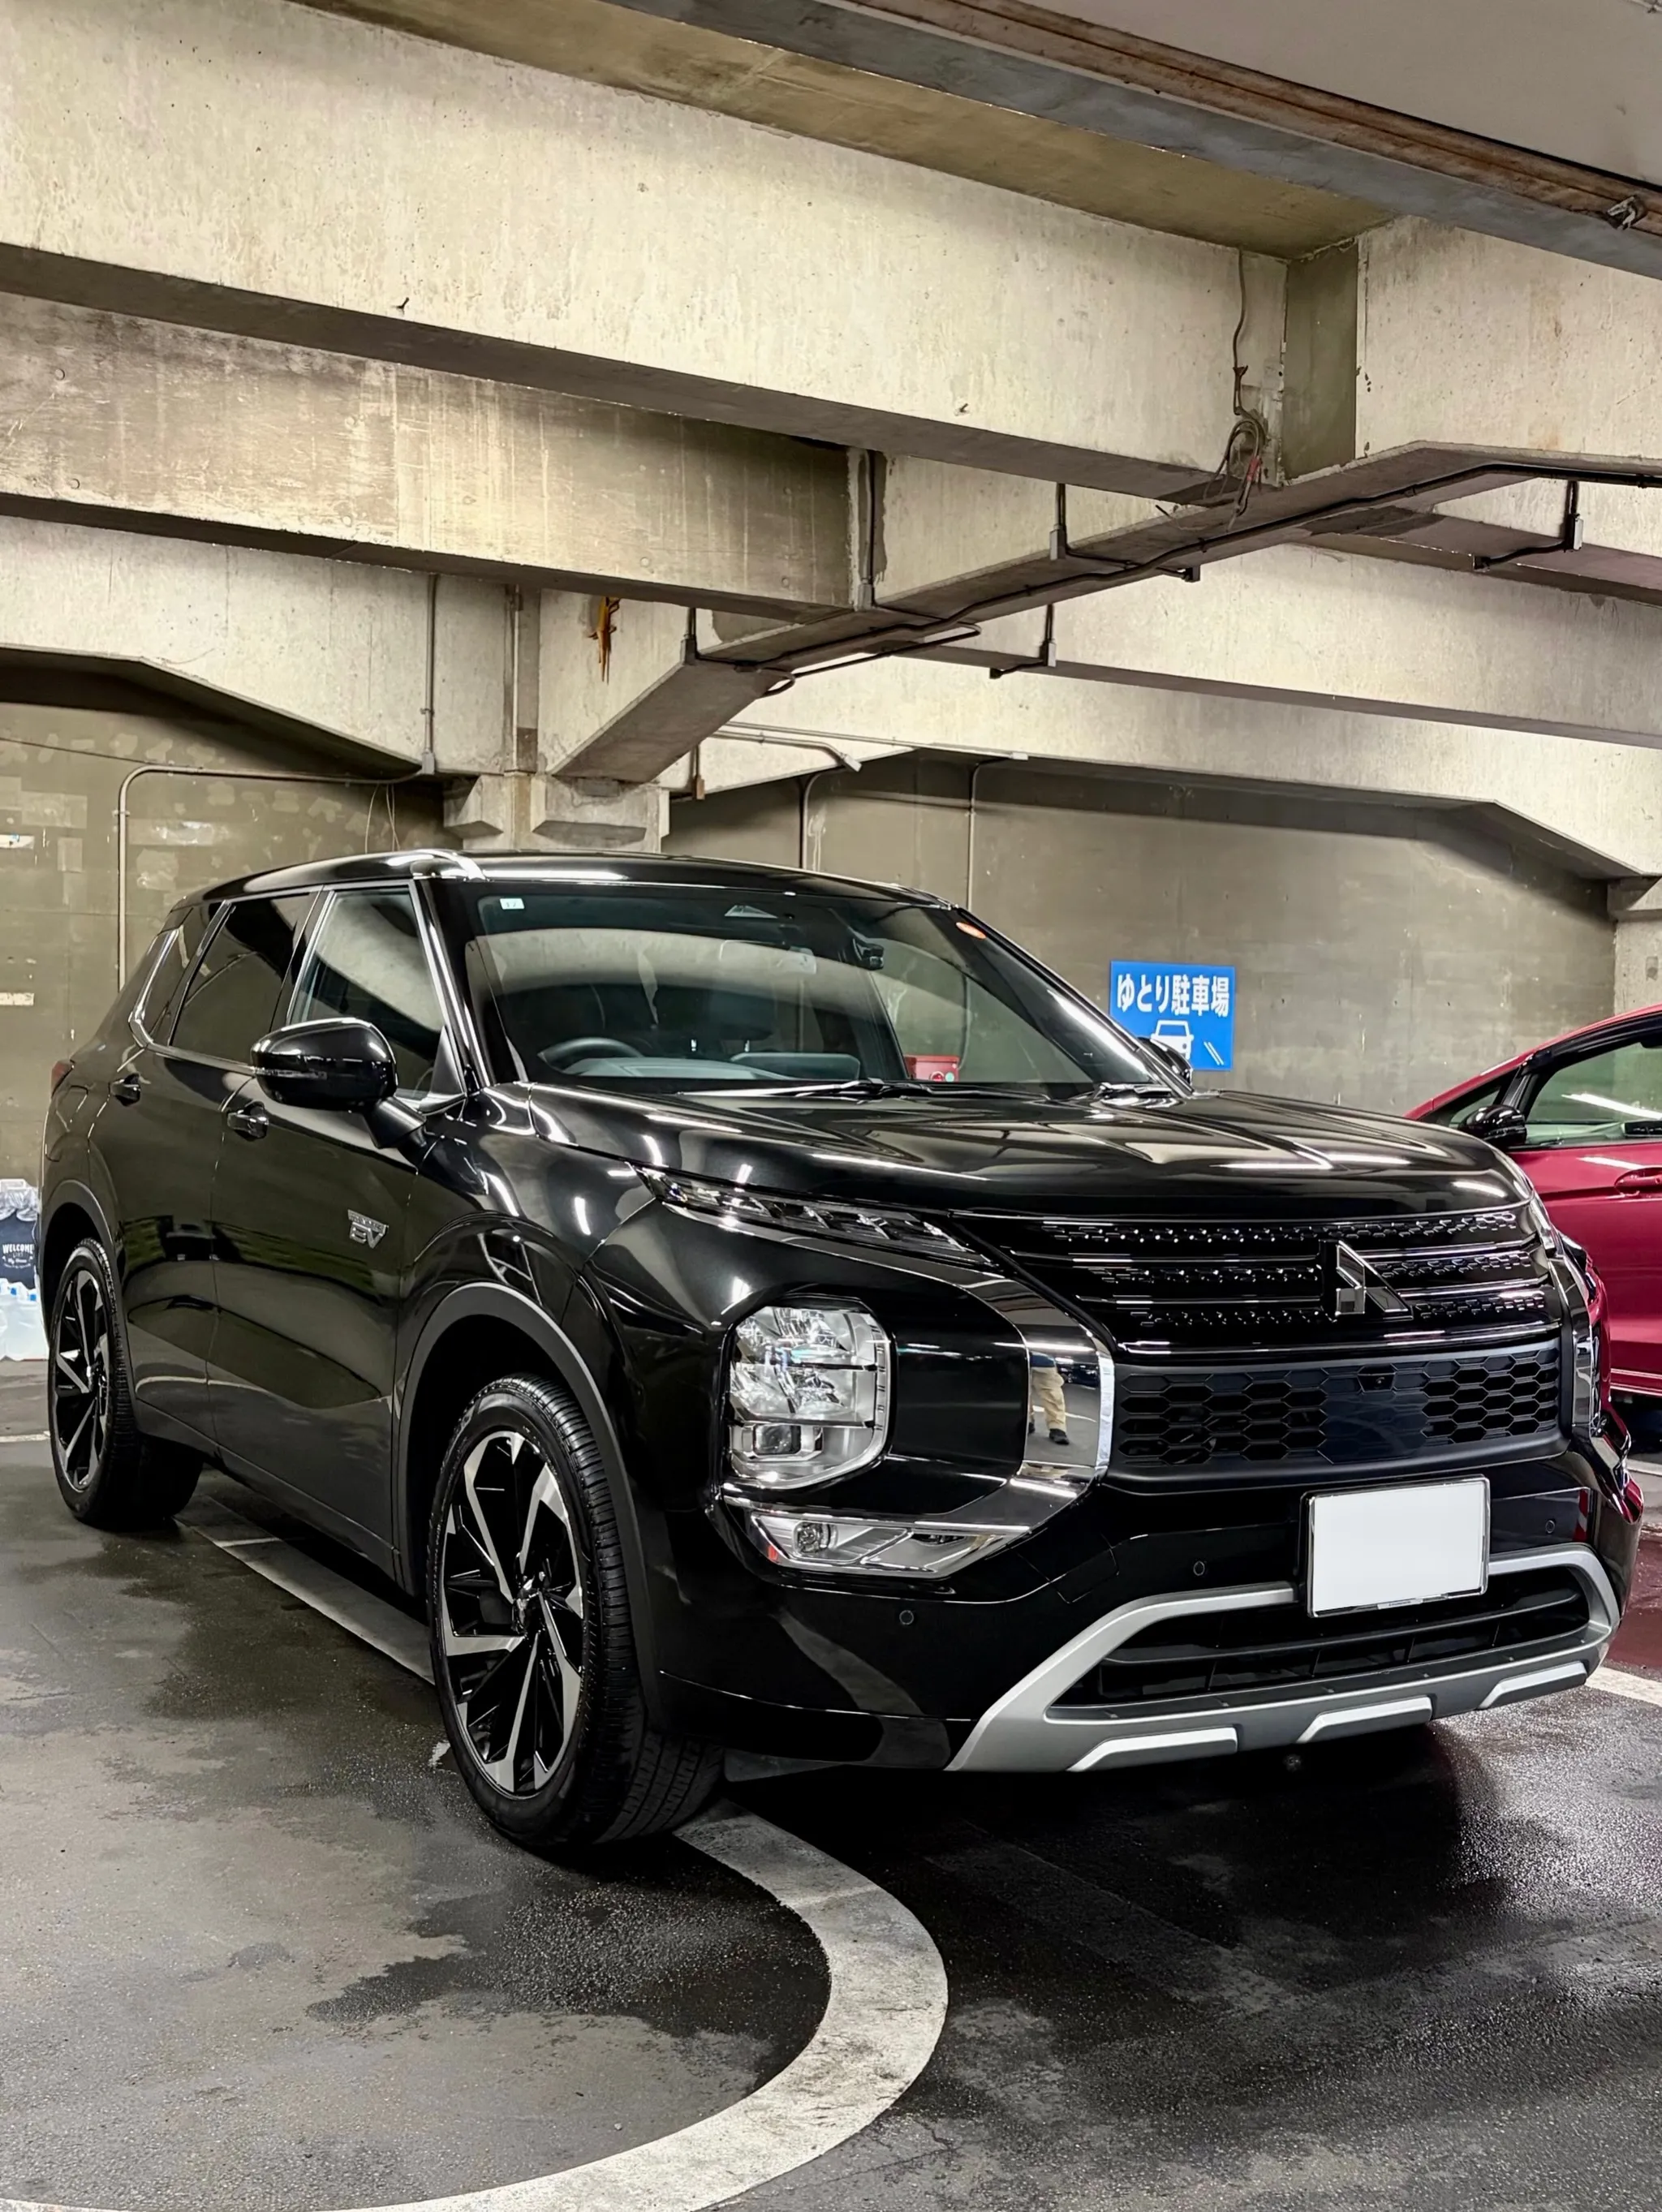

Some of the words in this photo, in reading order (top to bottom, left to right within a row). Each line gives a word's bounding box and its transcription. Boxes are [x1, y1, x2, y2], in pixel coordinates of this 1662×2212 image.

[1117, 973, 1229, 1018] ゆとり駐車場
[2, 1243, 34, 1254] WELCOME
